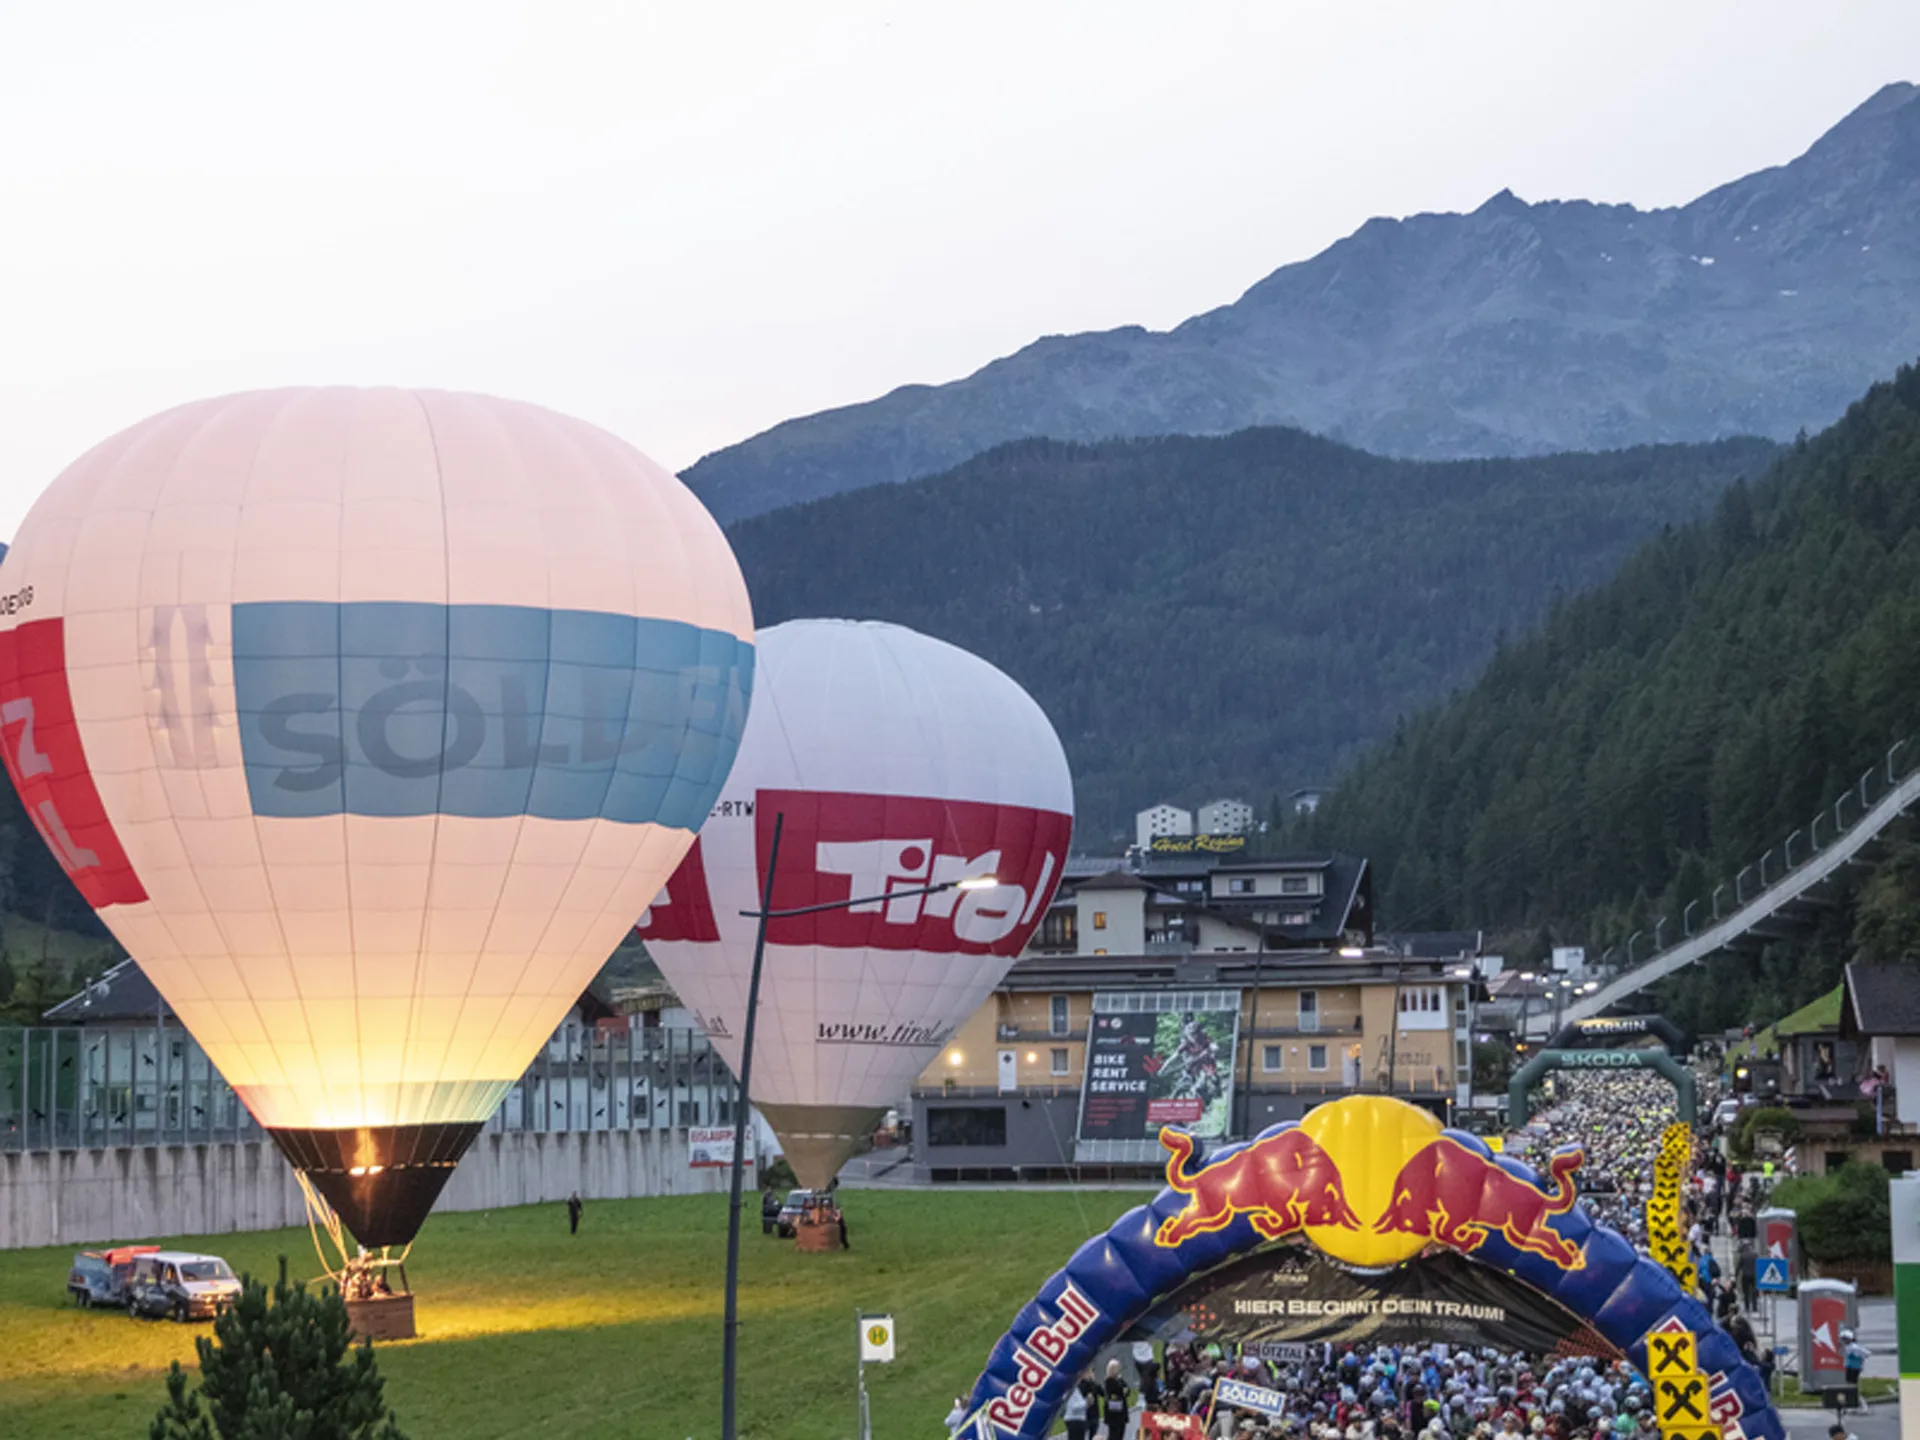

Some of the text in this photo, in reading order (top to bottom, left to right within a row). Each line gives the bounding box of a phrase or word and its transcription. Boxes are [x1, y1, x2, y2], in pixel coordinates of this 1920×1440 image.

[815, 838, 1056, 943] Tirol
[1581, 1019, 1647, 1034] GARMIN
[1093, 1054, 1127, 1066] BIKE
[1092, 1067, 1129, 1079] RENT
[1090, 1080, 1147, 1092] SERVICE
[1234, 1300, 1505, 1321] HIER BEGINNT DEIN TRAUM!
[872, 1329, 884, 1342] H
[988, 1286, 1100, 1435] Red Bull
[1220, 1383, 1279, 1408] SÖLDEN
